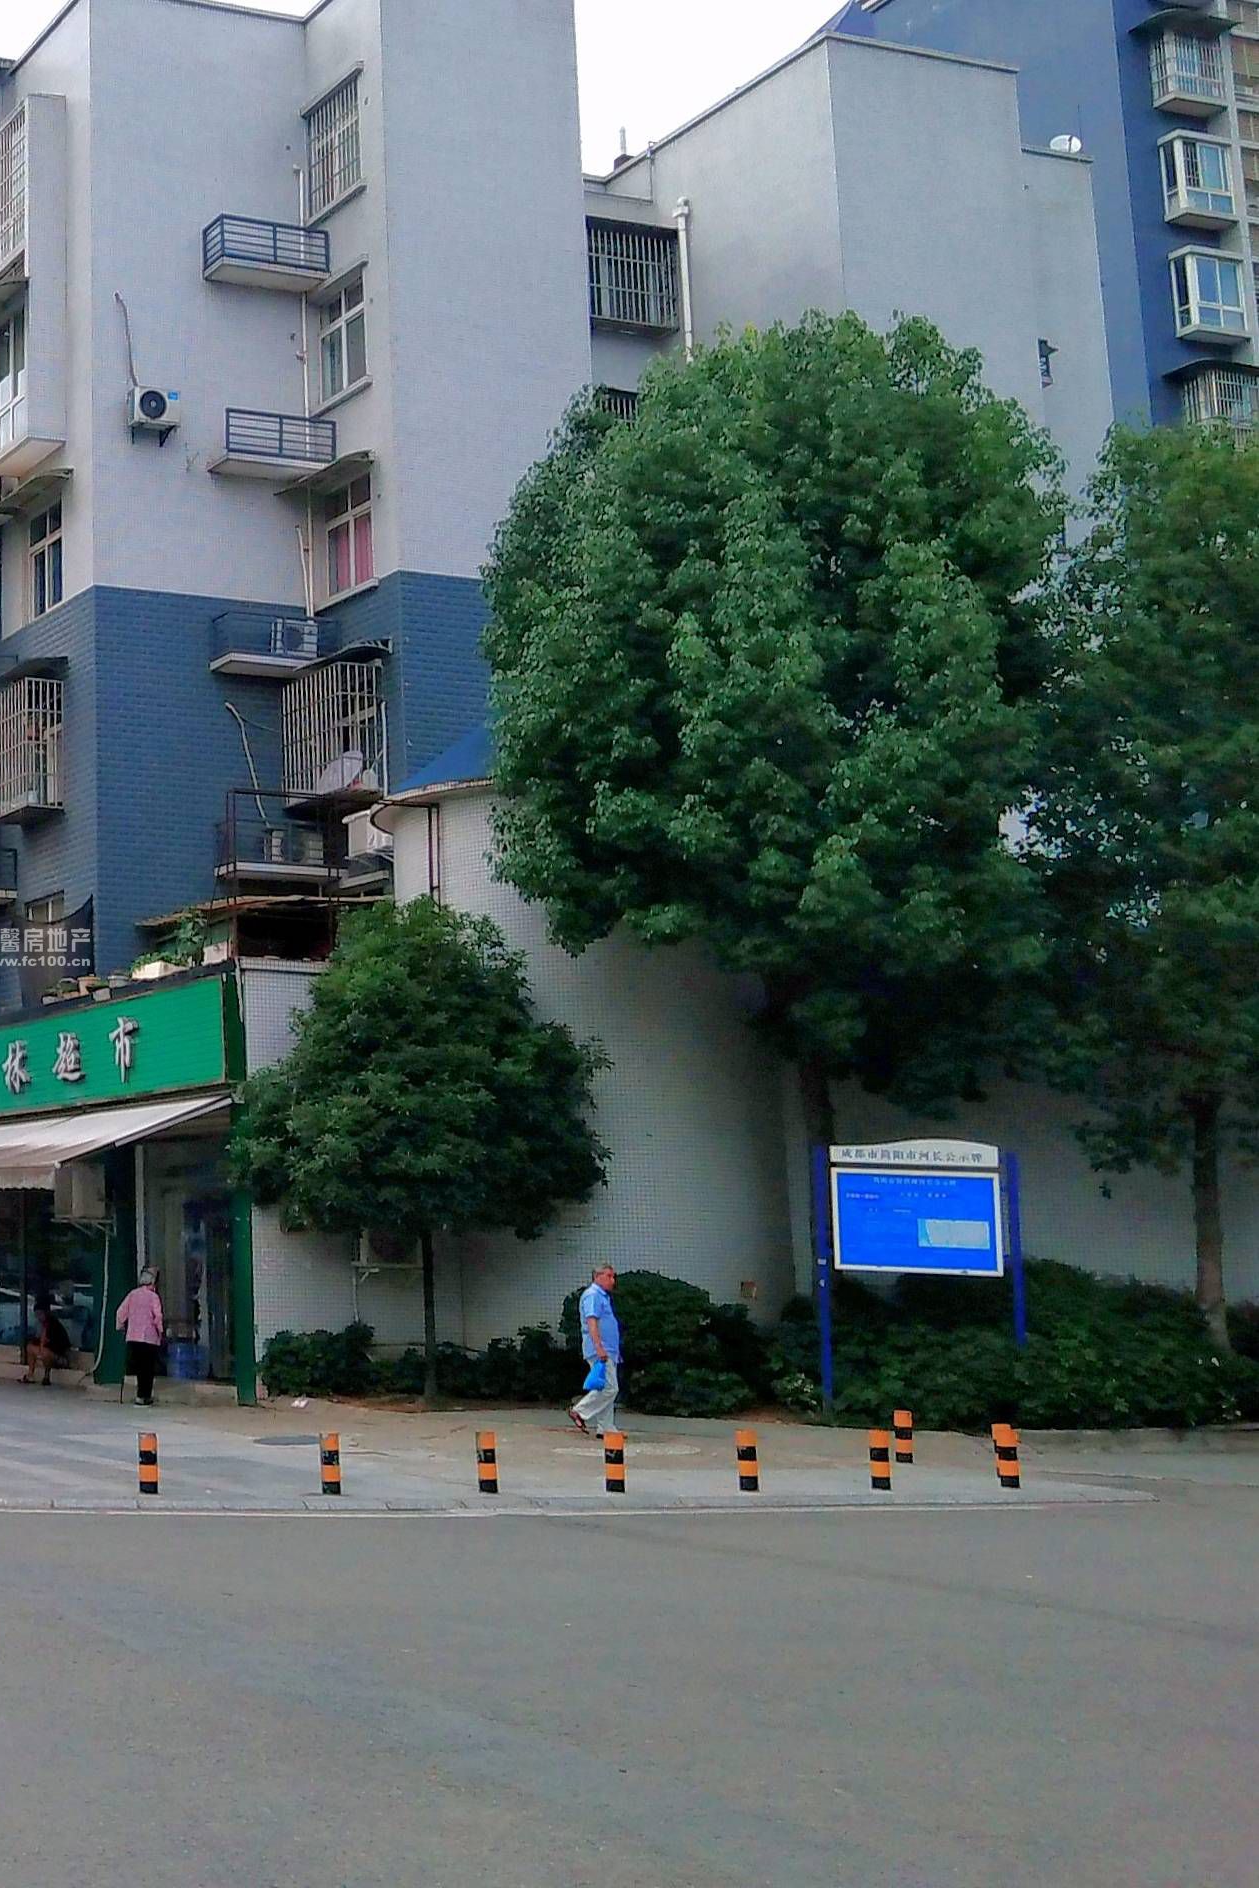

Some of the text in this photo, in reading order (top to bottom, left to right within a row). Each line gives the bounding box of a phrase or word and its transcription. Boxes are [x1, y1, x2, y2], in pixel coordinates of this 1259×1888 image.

[841, 1149, 983, 1164] 成都市简阳市河长公示牌
